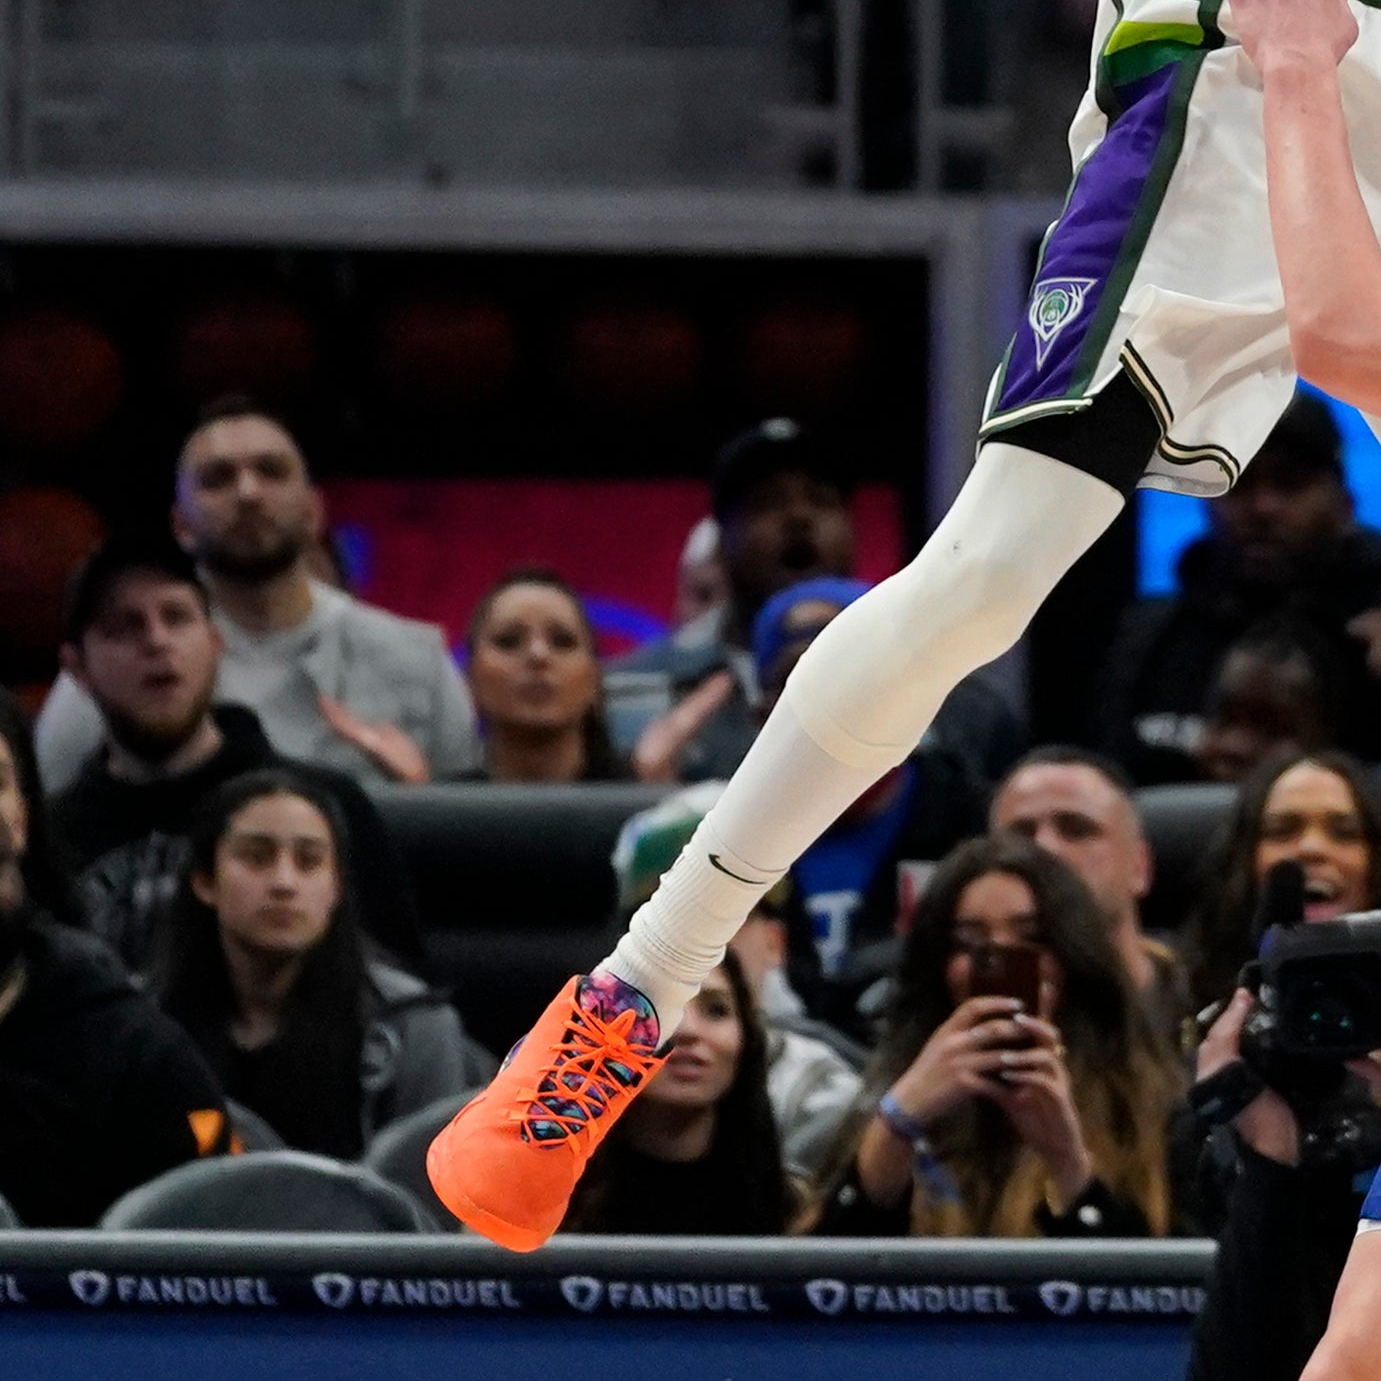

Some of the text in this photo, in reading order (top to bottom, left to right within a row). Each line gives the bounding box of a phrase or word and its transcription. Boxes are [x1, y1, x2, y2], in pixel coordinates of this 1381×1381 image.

[116, 1274, 280, 1307] FANDUEL
[359, 1277, 522, 1309] FANDUEL
[607, 1280, 771, 1313] FANDUEL
[852, 1283, 1016, 1314] FANDUEL
